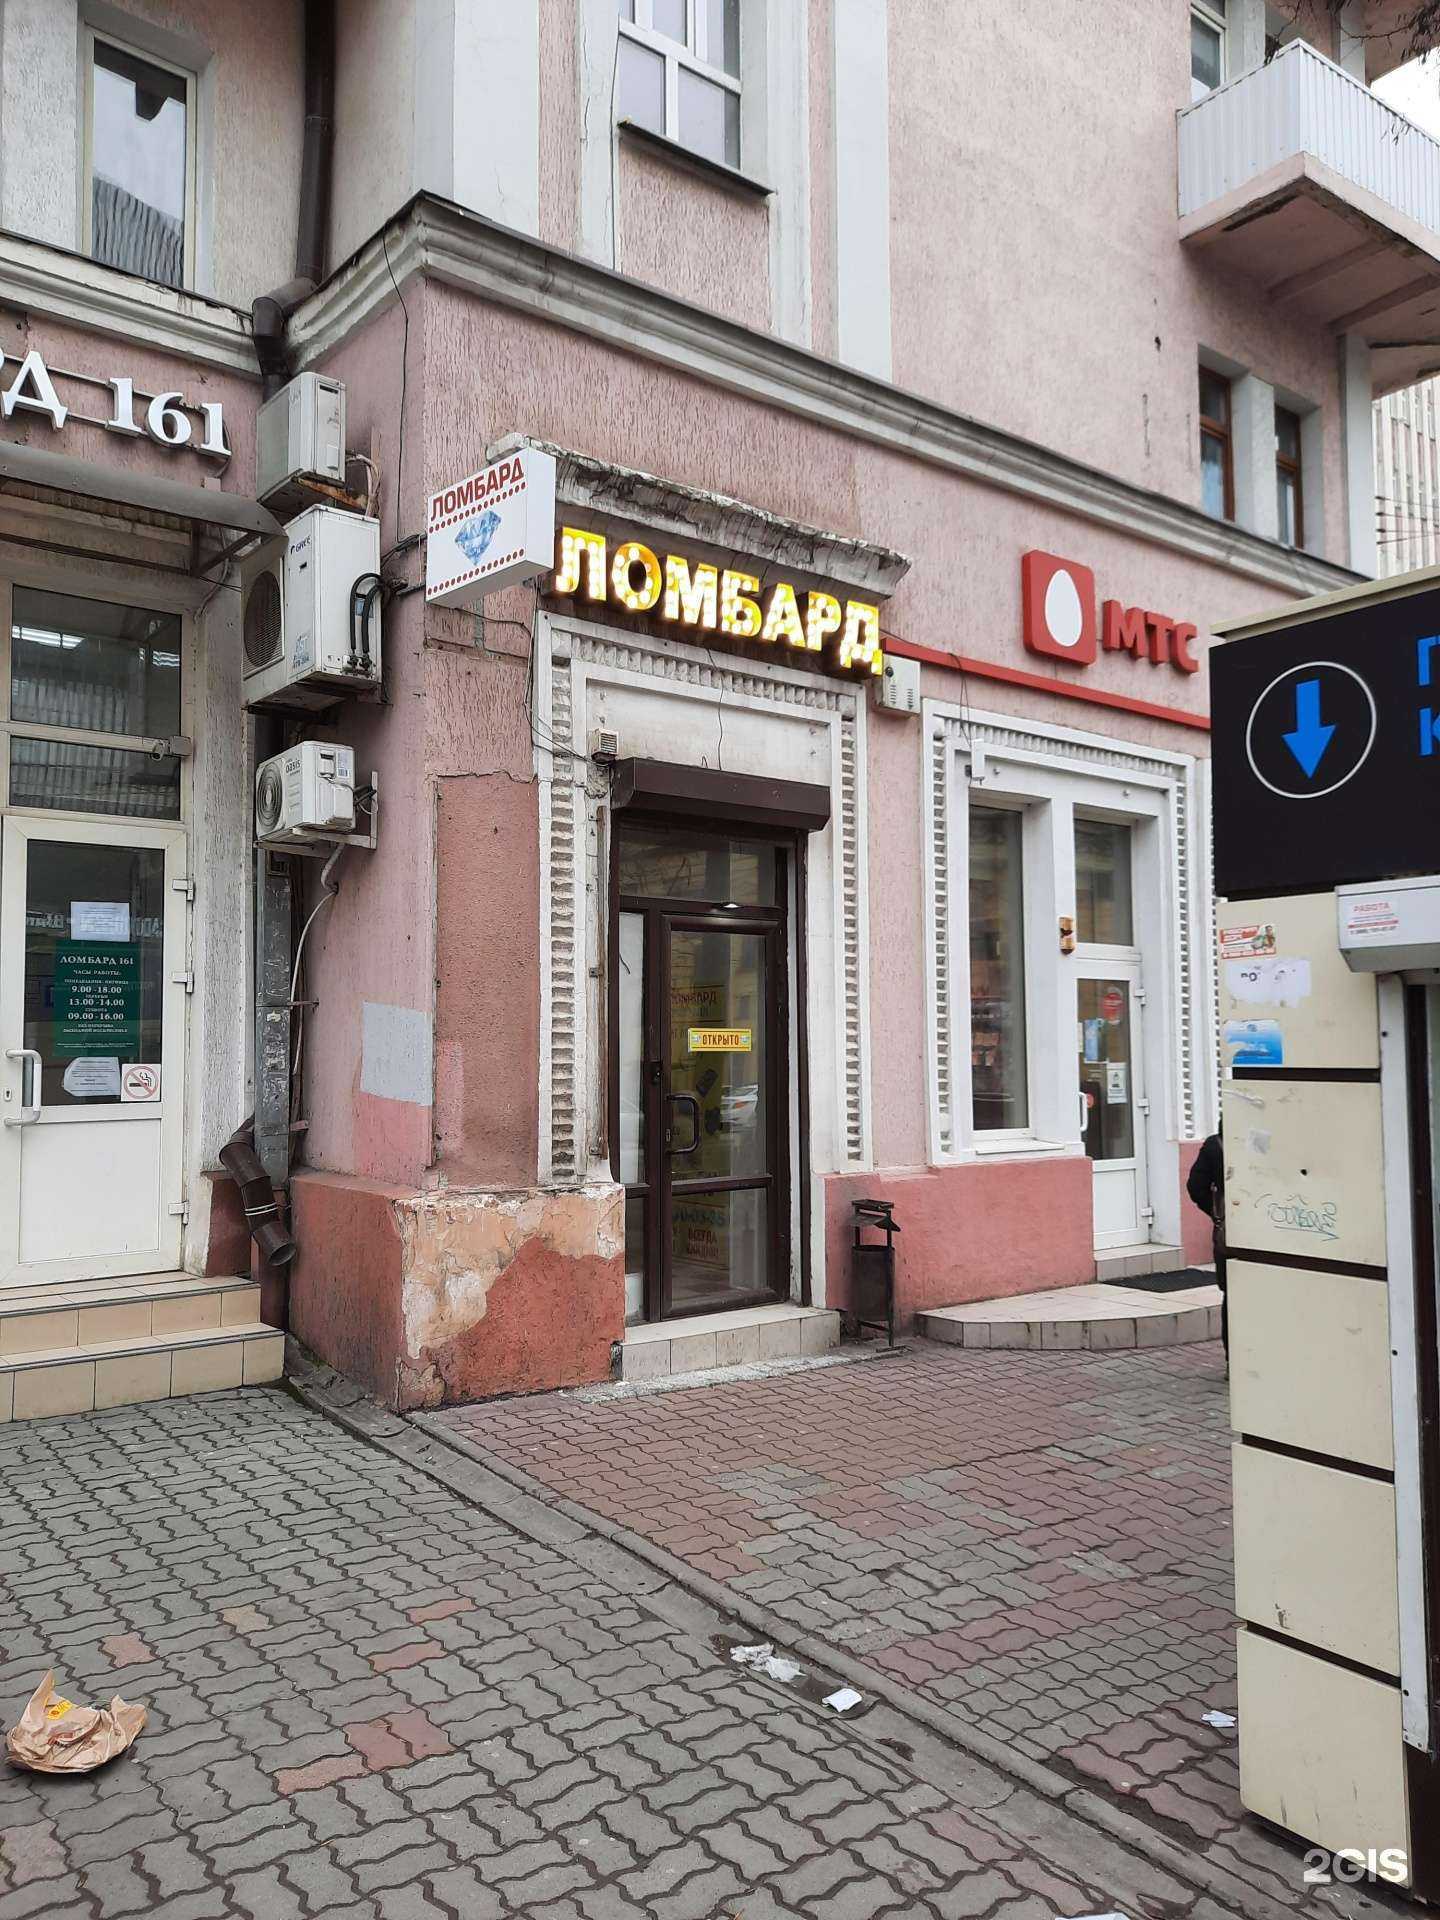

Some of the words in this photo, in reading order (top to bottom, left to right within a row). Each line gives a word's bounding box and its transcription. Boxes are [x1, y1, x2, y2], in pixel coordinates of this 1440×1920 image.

[0, 347, 68, 430] Д
[105, 377, 232, 456] 161
[430, 457, 525, 522] ЛОМБАРД
[555, 526, 883, 676] ЛОМБАРД
[1102, 599, 1200, 674] МТС
[60, 955, 117, 966] ЛОМБАРД
[119, 957, 134, 965] 161
[71, 985, 92, 993] 9.00
[69, 998, 94, 1006] 13.00
[67, 1012, 94, 1020] 09.00
[702, 1034, 740, 1046] ОТКРЫТО
